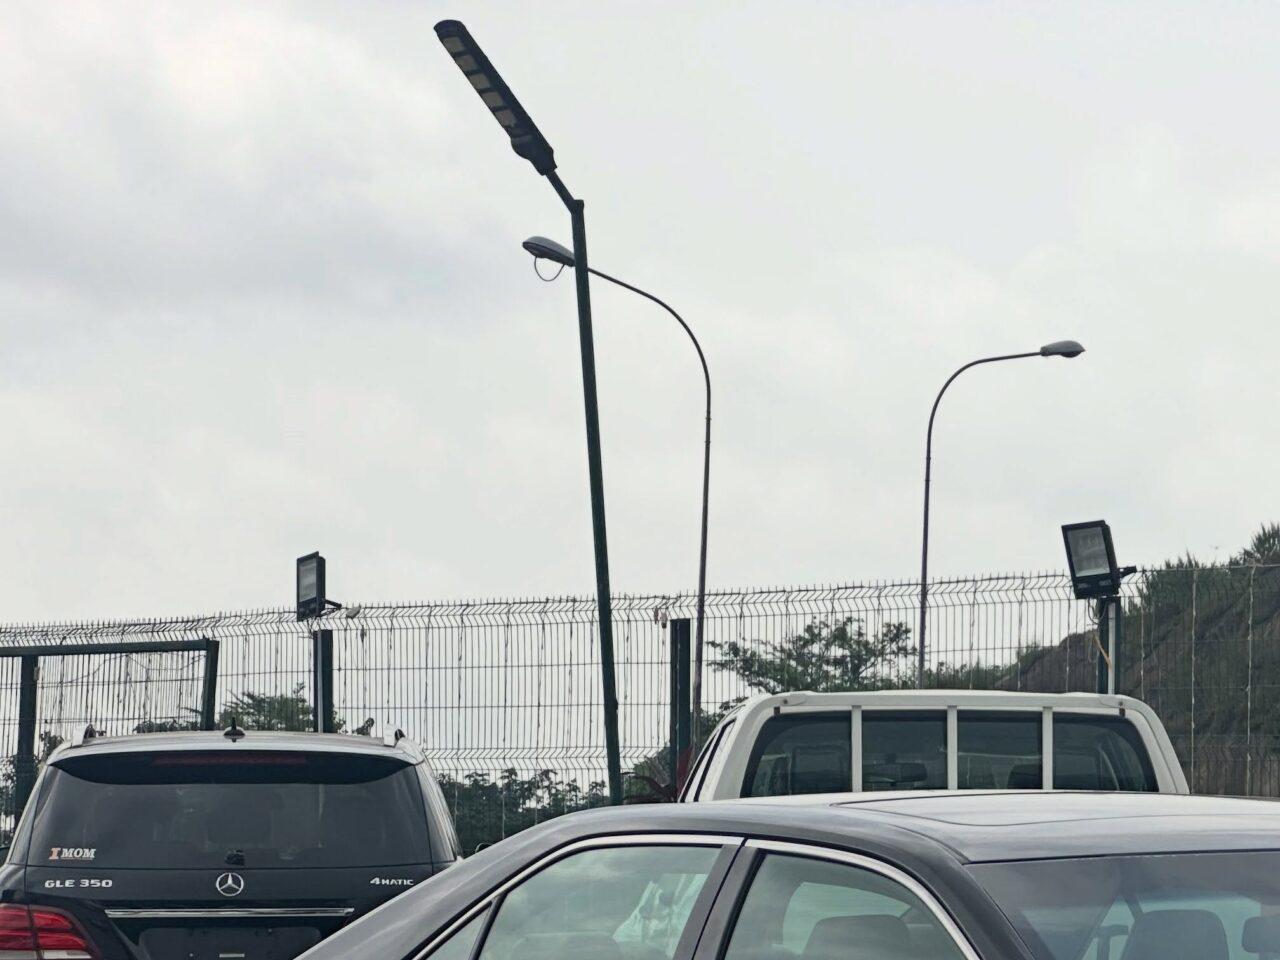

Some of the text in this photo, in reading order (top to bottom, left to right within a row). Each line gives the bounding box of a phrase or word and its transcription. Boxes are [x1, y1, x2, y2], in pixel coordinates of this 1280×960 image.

[60, 848, 97, 859] MOM
[44, 879, 113, 888] GLE 350
[369, 876, 415, 886] 4MATIC
